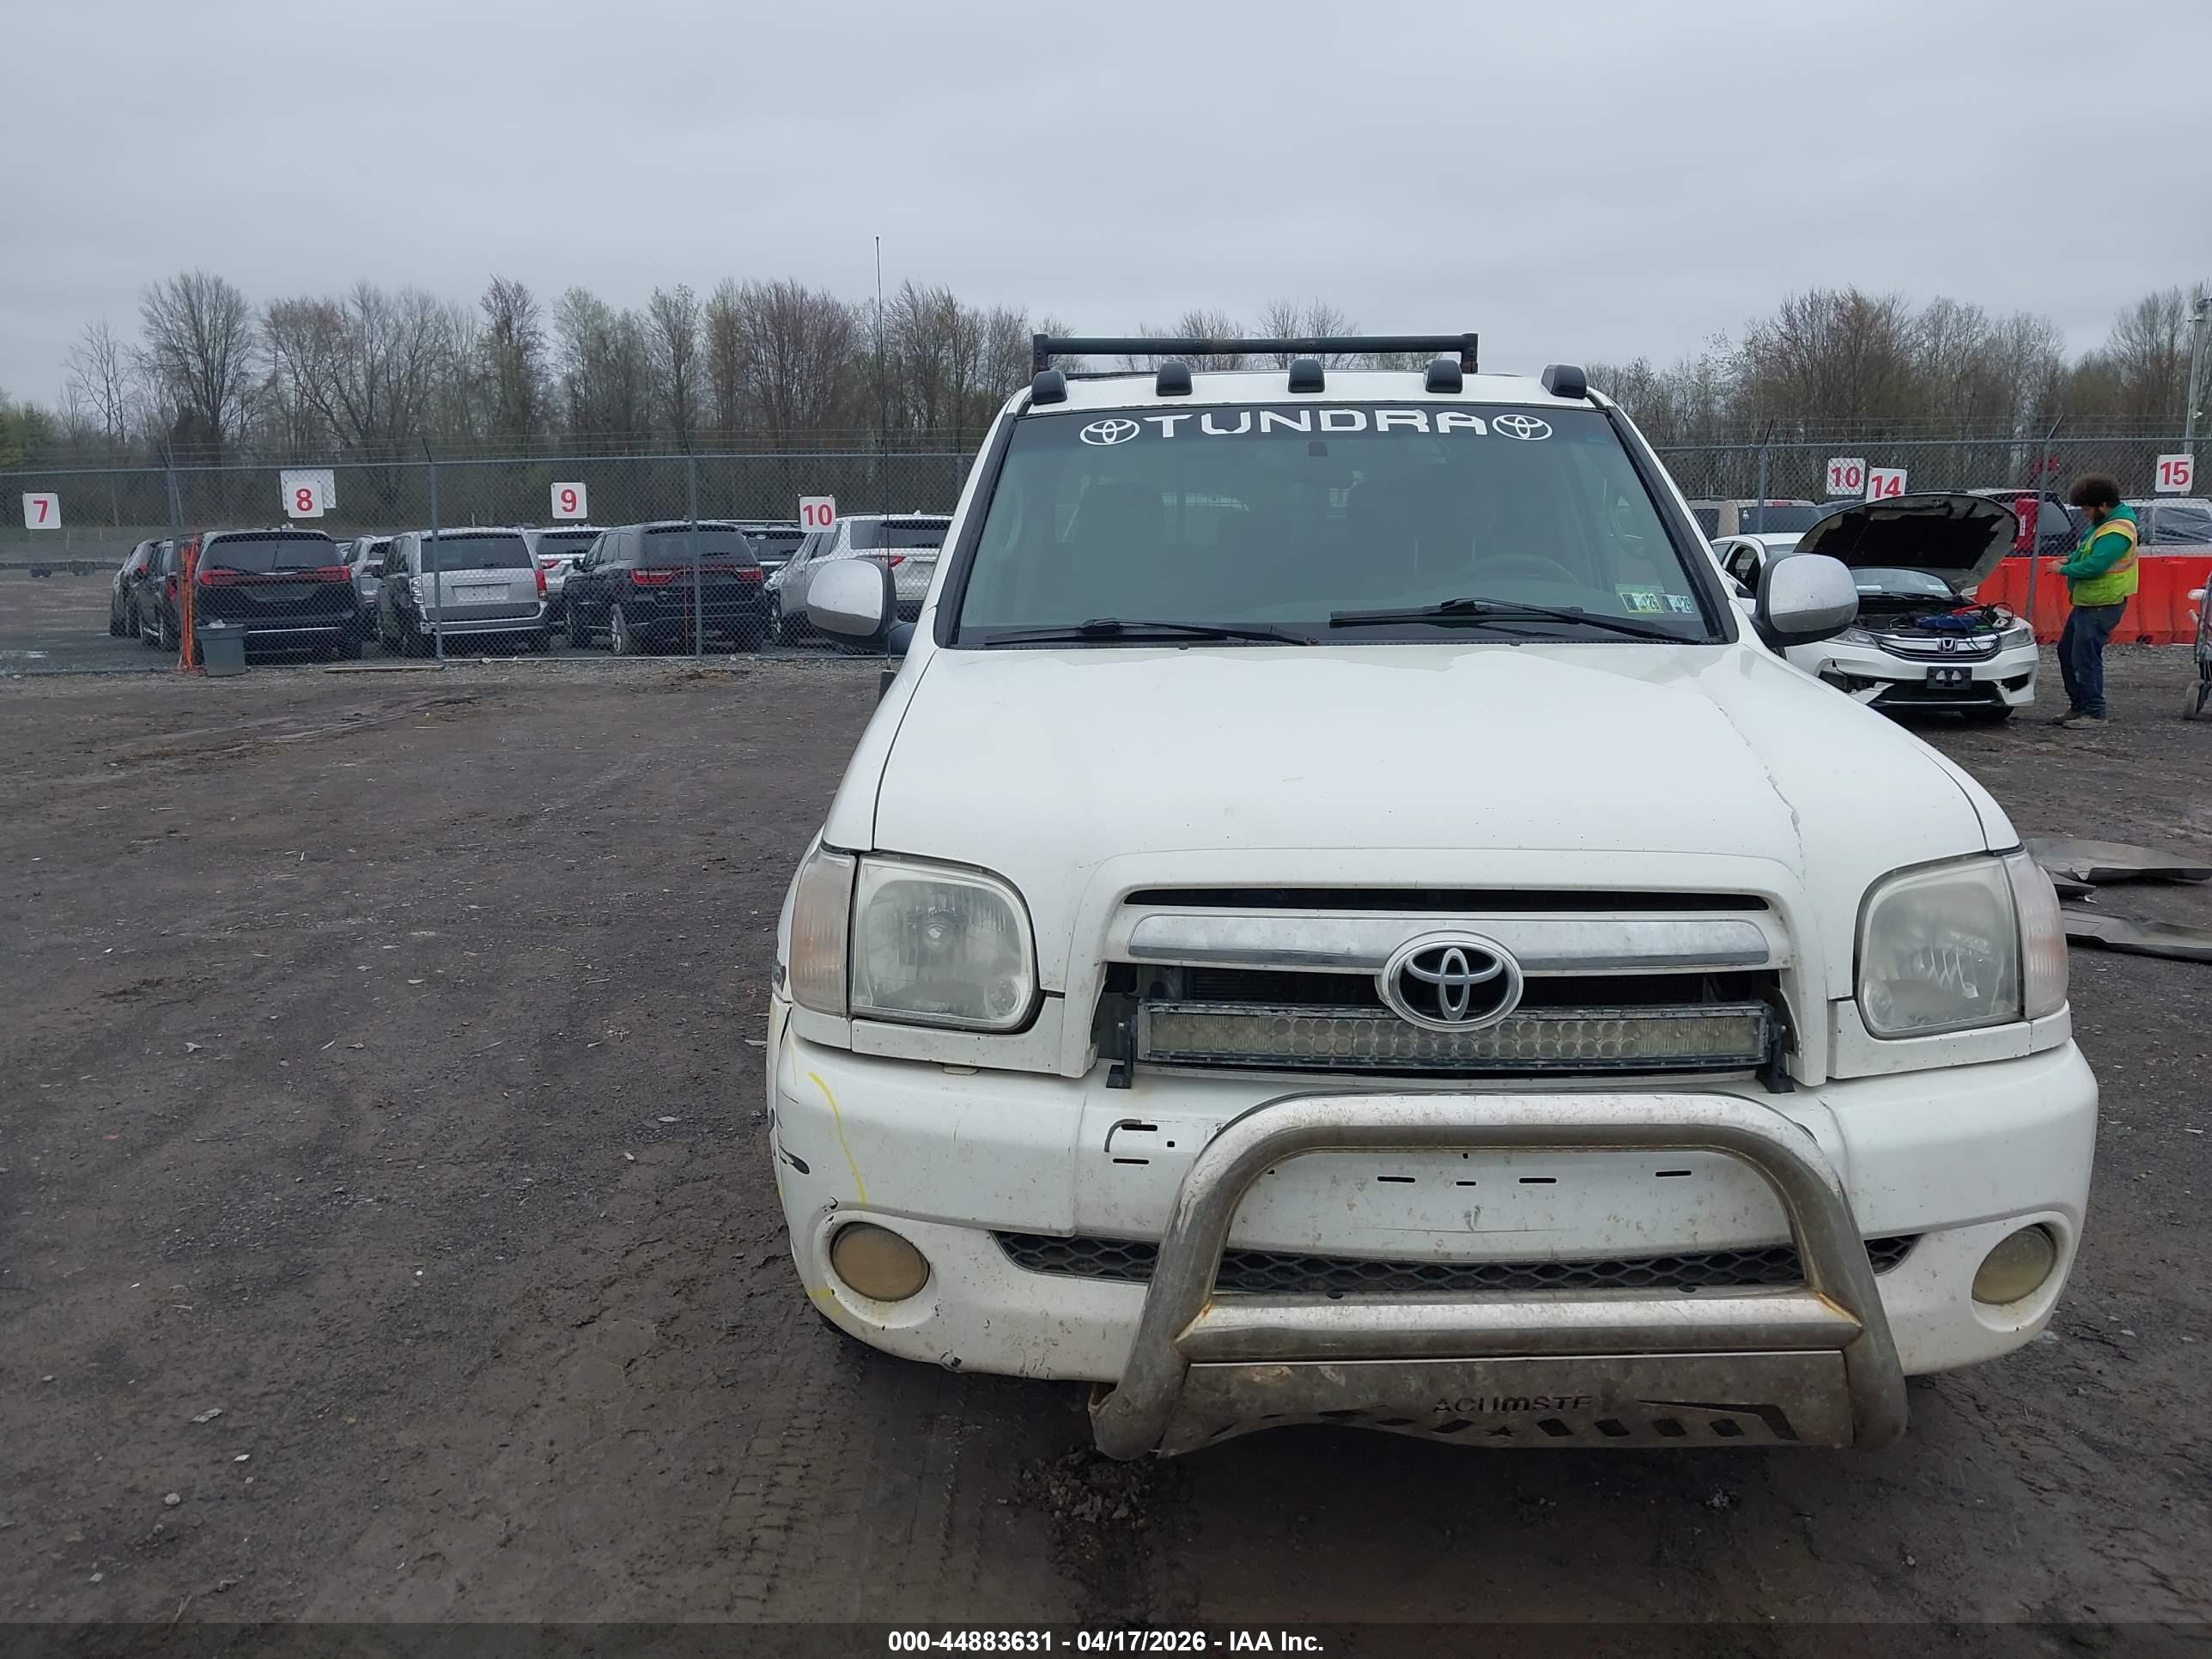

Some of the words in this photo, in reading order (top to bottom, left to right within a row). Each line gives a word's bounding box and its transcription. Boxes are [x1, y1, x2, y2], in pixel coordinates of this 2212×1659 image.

[1142, 409, 1488, 439] TUNDRA
[1831, 466, 1861, 488] 10
[2159, 461, 2190, 486] 15
[1871, 475, 1901, 498] 14
[33, 500, 49, 523] 7
[295, 488, 313, 512] 8
[560, 489, 578, 513] 9
[802, 504, 833, 526] 10
